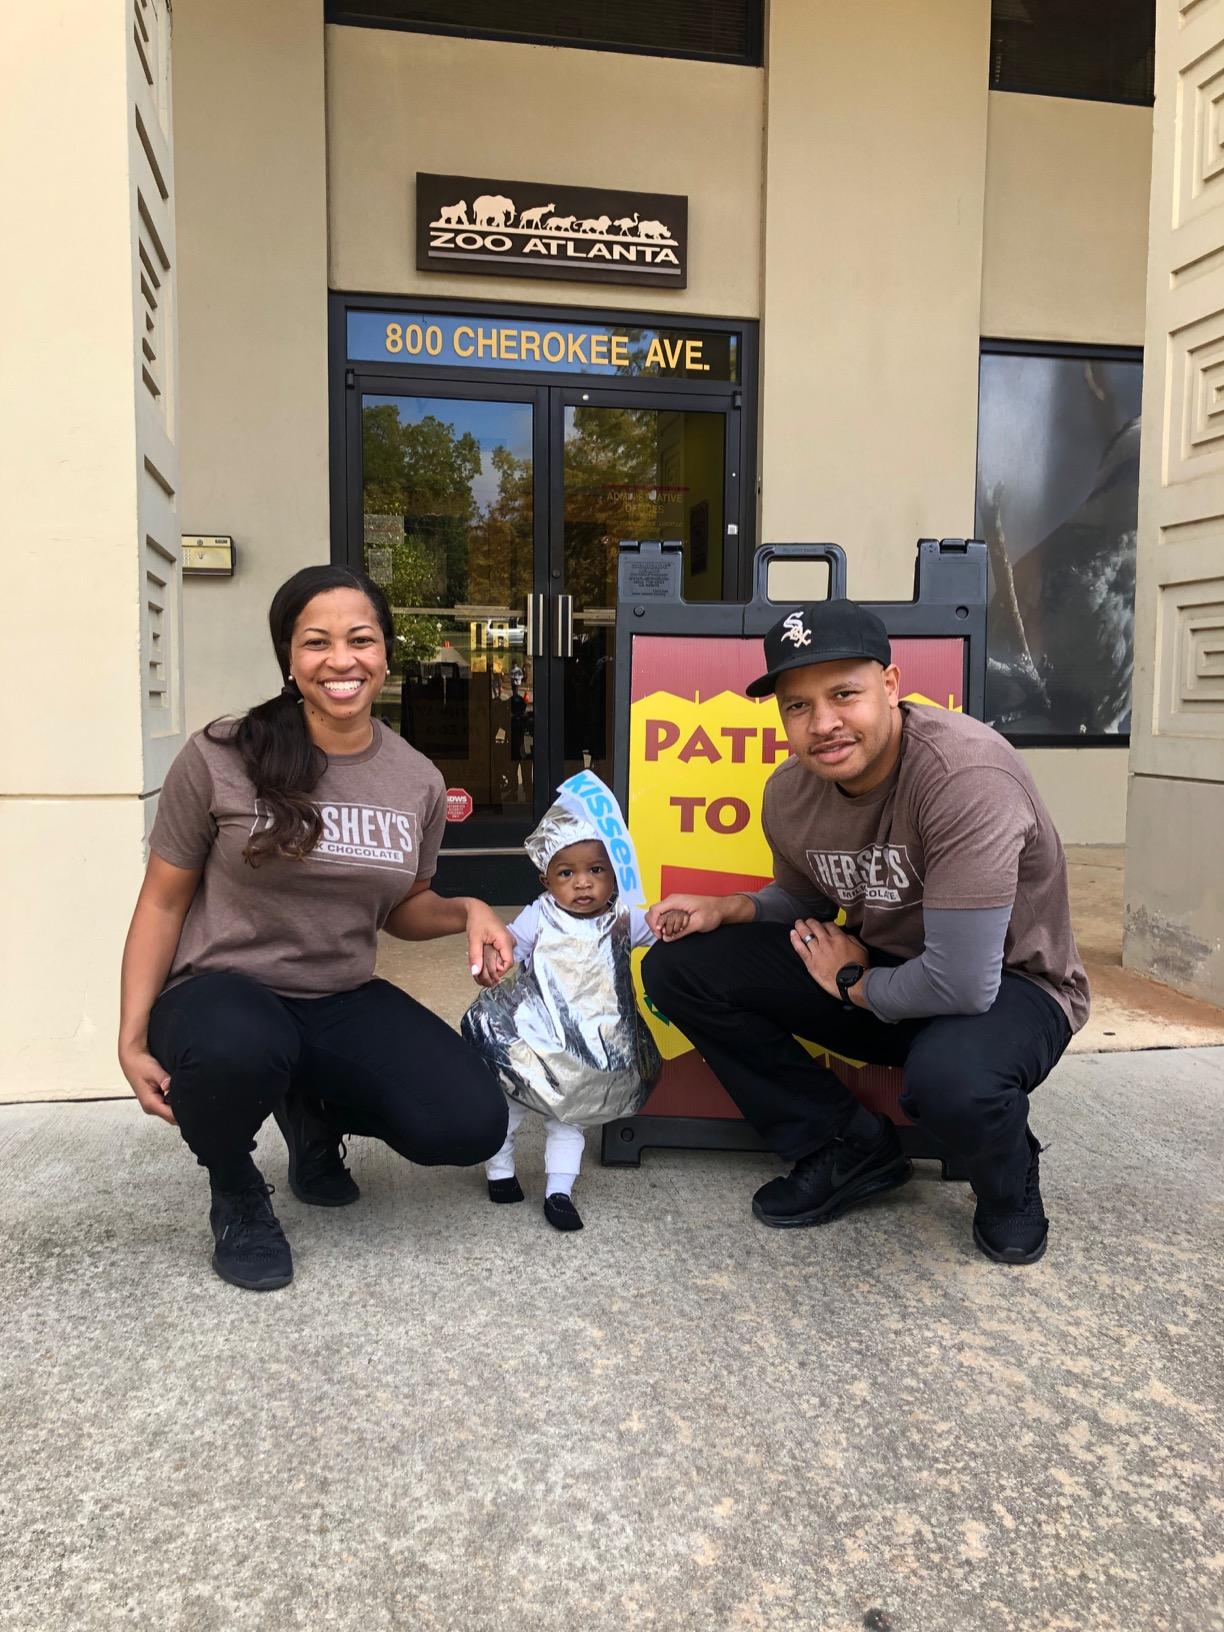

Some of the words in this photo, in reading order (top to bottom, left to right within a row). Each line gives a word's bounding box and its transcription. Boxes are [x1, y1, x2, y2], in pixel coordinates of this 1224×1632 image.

[429, 231, 513, 253] ZOO
[521, 238, 680, 265] ATLANTA
[385, 322, 443, 357] 800
[453, 325, 630, 366] CHEROKEE
[644, 338, 711, 372] AVE.
[321, 806, 413, 851] SHEY'S
[669, 796, 751, 835] TO
[327, 843, 401, 861] CHOCOLATE
